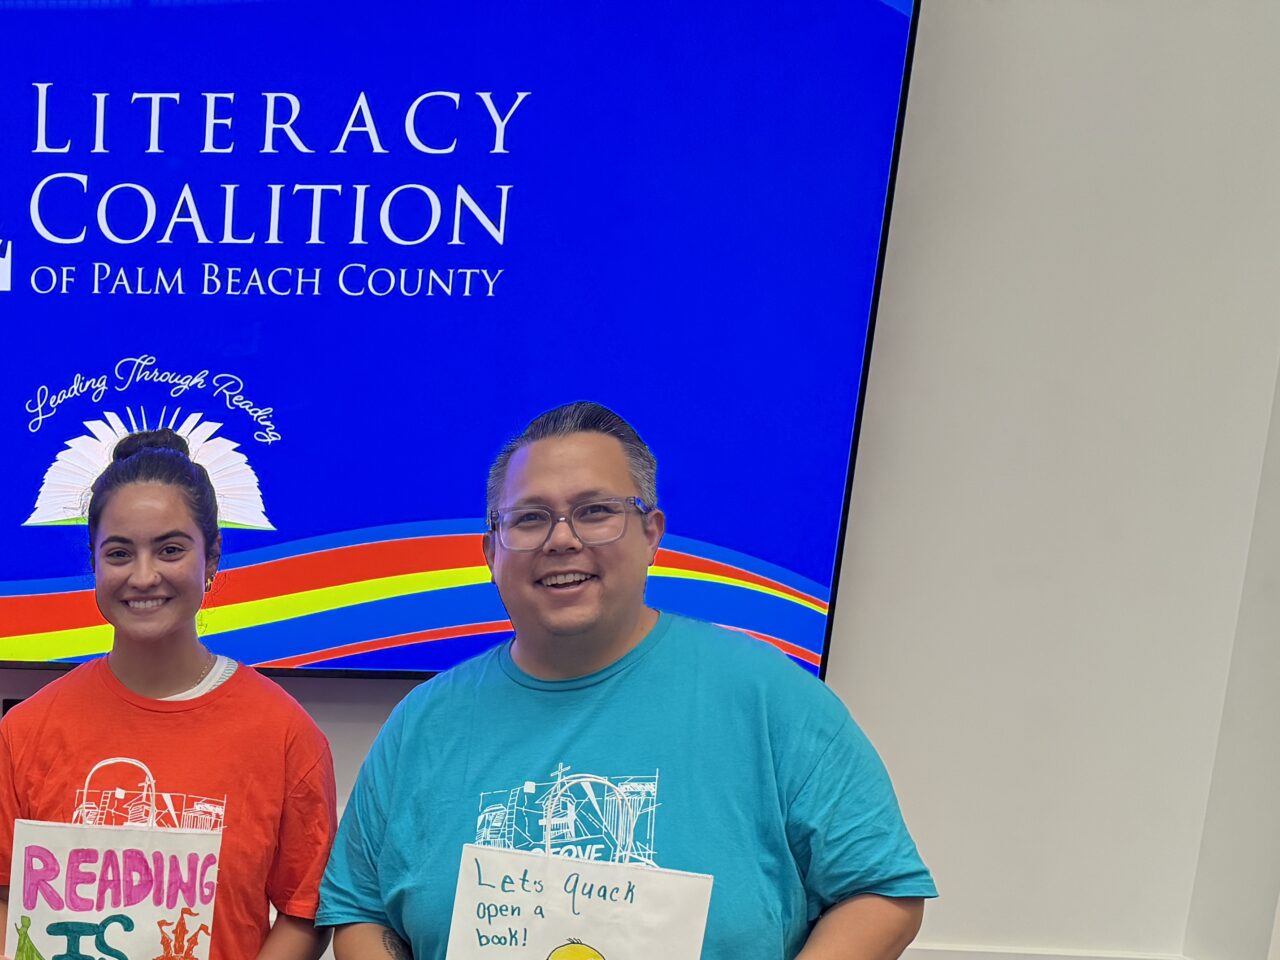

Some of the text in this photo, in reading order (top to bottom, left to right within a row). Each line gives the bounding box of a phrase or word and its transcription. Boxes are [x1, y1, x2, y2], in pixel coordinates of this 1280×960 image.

[31, 82, 531, 154] LITERACY
[29, 172, 513, 246] COALITION
[30, 262, 504, 297] OF PALM BEACH COUNTY
[25, 354, 281, 444] Leading Through Reading
[22, 845, 217, 912] READING
[475, 928, 528, 948] book!
[476, 901, 545, 925] open a
